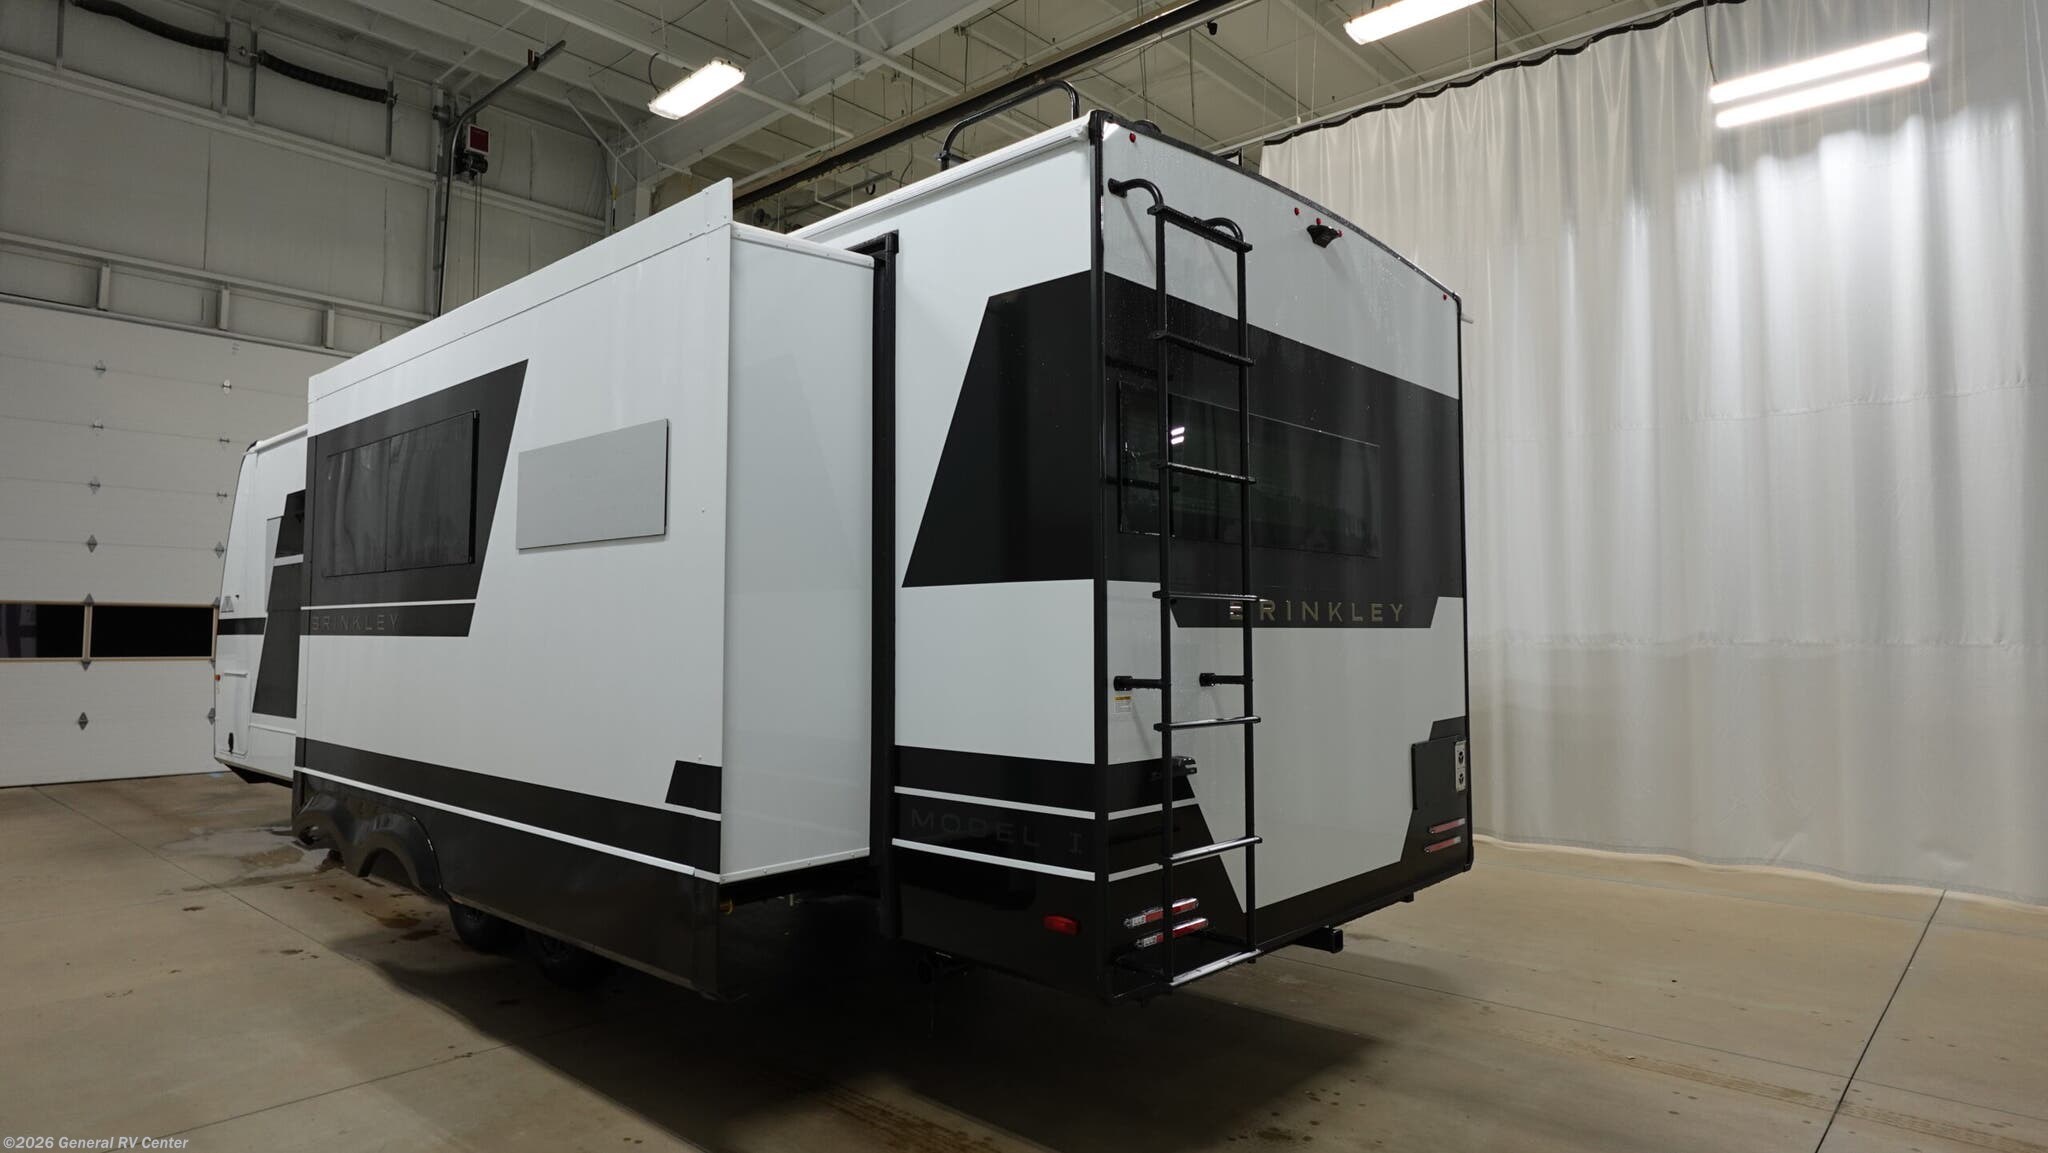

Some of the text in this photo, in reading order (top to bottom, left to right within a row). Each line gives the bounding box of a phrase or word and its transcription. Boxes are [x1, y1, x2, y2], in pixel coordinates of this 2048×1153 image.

[1230, 599, 1403, 622] BRINKLEY
[311, 614, 399, 631] BRINKLEY
[911, 809, 1041, 847] MODEL
